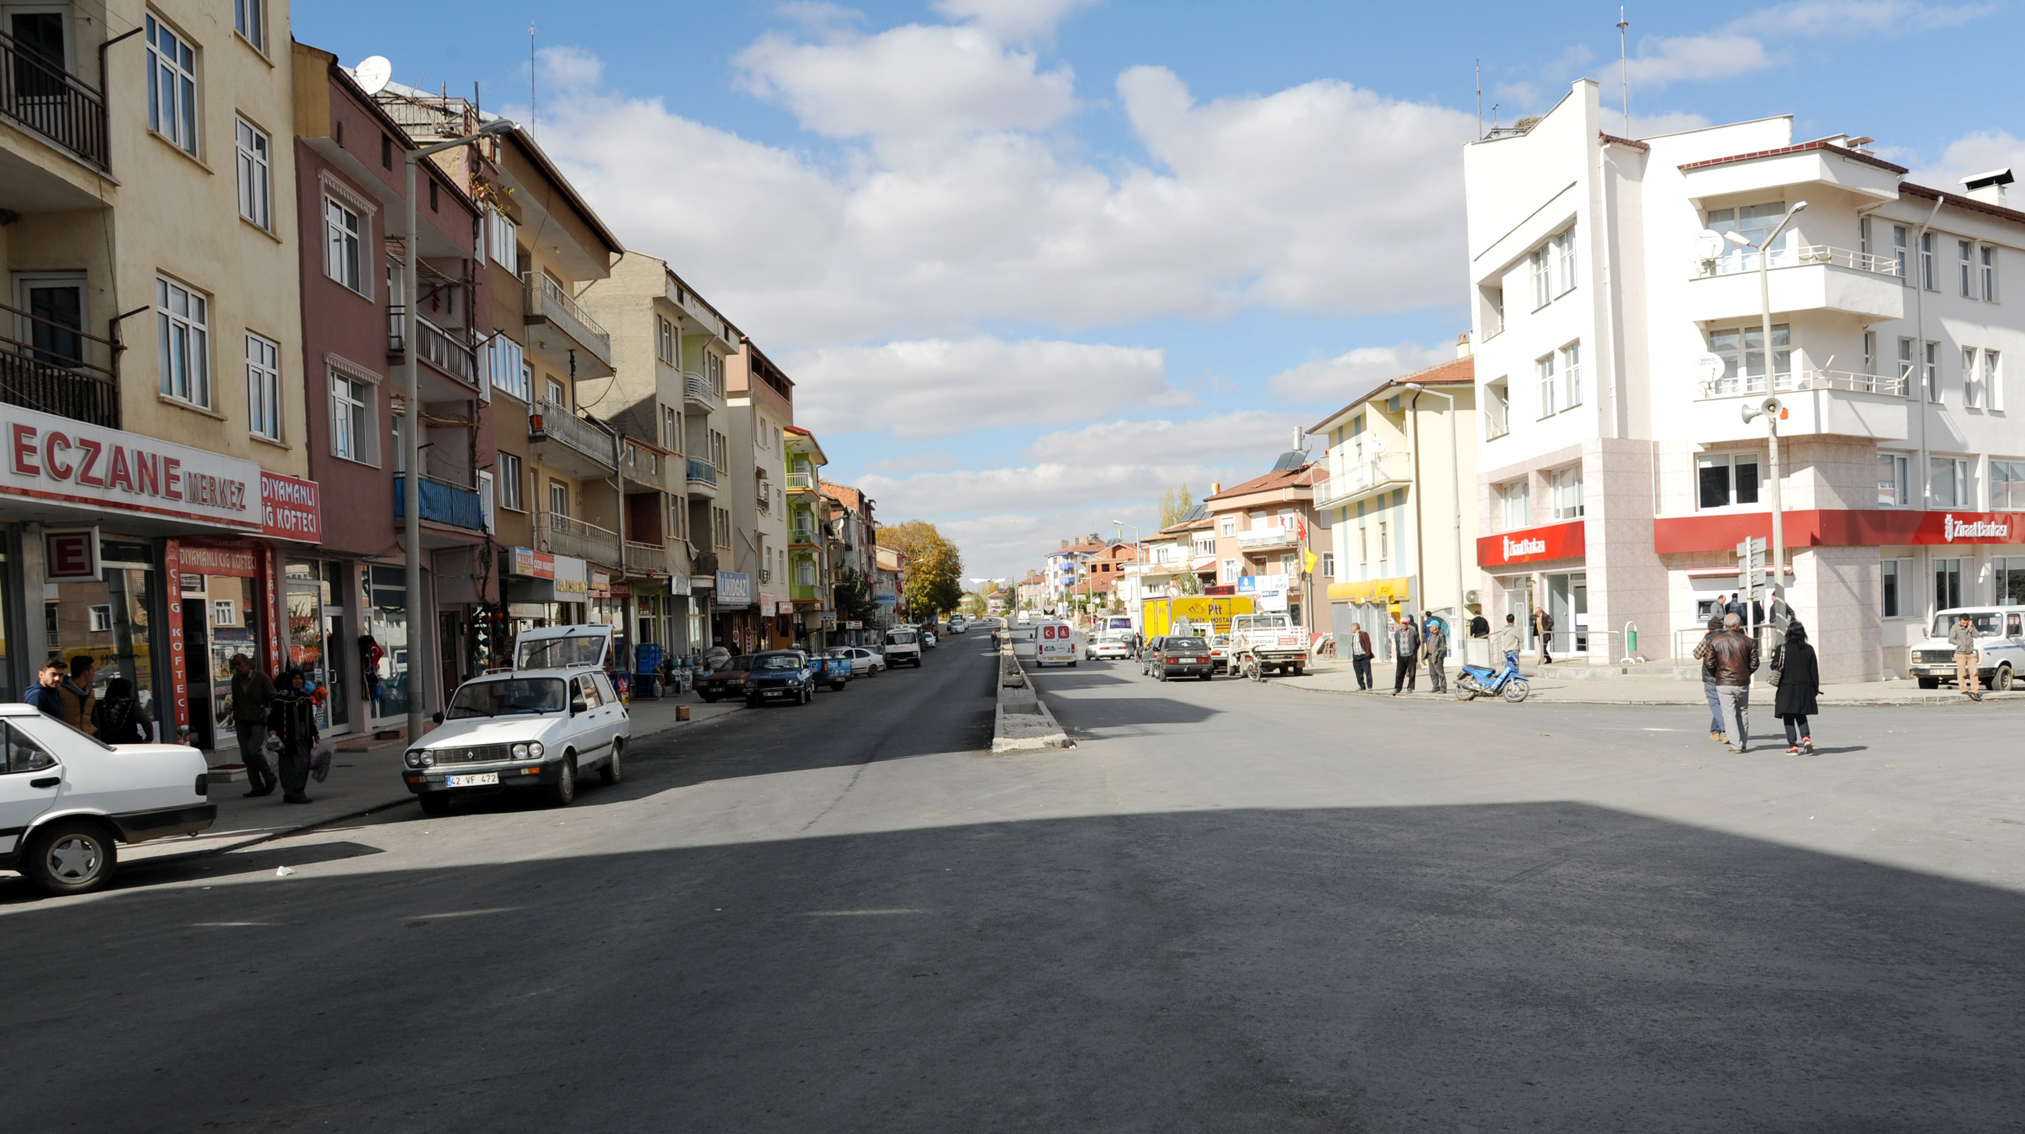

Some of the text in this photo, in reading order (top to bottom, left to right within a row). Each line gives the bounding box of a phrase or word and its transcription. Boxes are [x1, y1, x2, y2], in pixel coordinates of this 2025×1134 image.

[7, 421, 247, 511] ECZANE MERKEZ
[277, 504, 317, 533] KÖFTECİ
[1954, 520, 2008, 537] Ziraat Bankası
[56, 537, 86, 571] E
[1509, 540, 1524, 556] Ziraat
[721, 573, 746, 597] LİKİDGAZ
[1208, 604, 1223, 615] Ptt
[172, 627, 186, 722] KÖFTECİ
[451, 774, 497, 785] 42 VF 472
